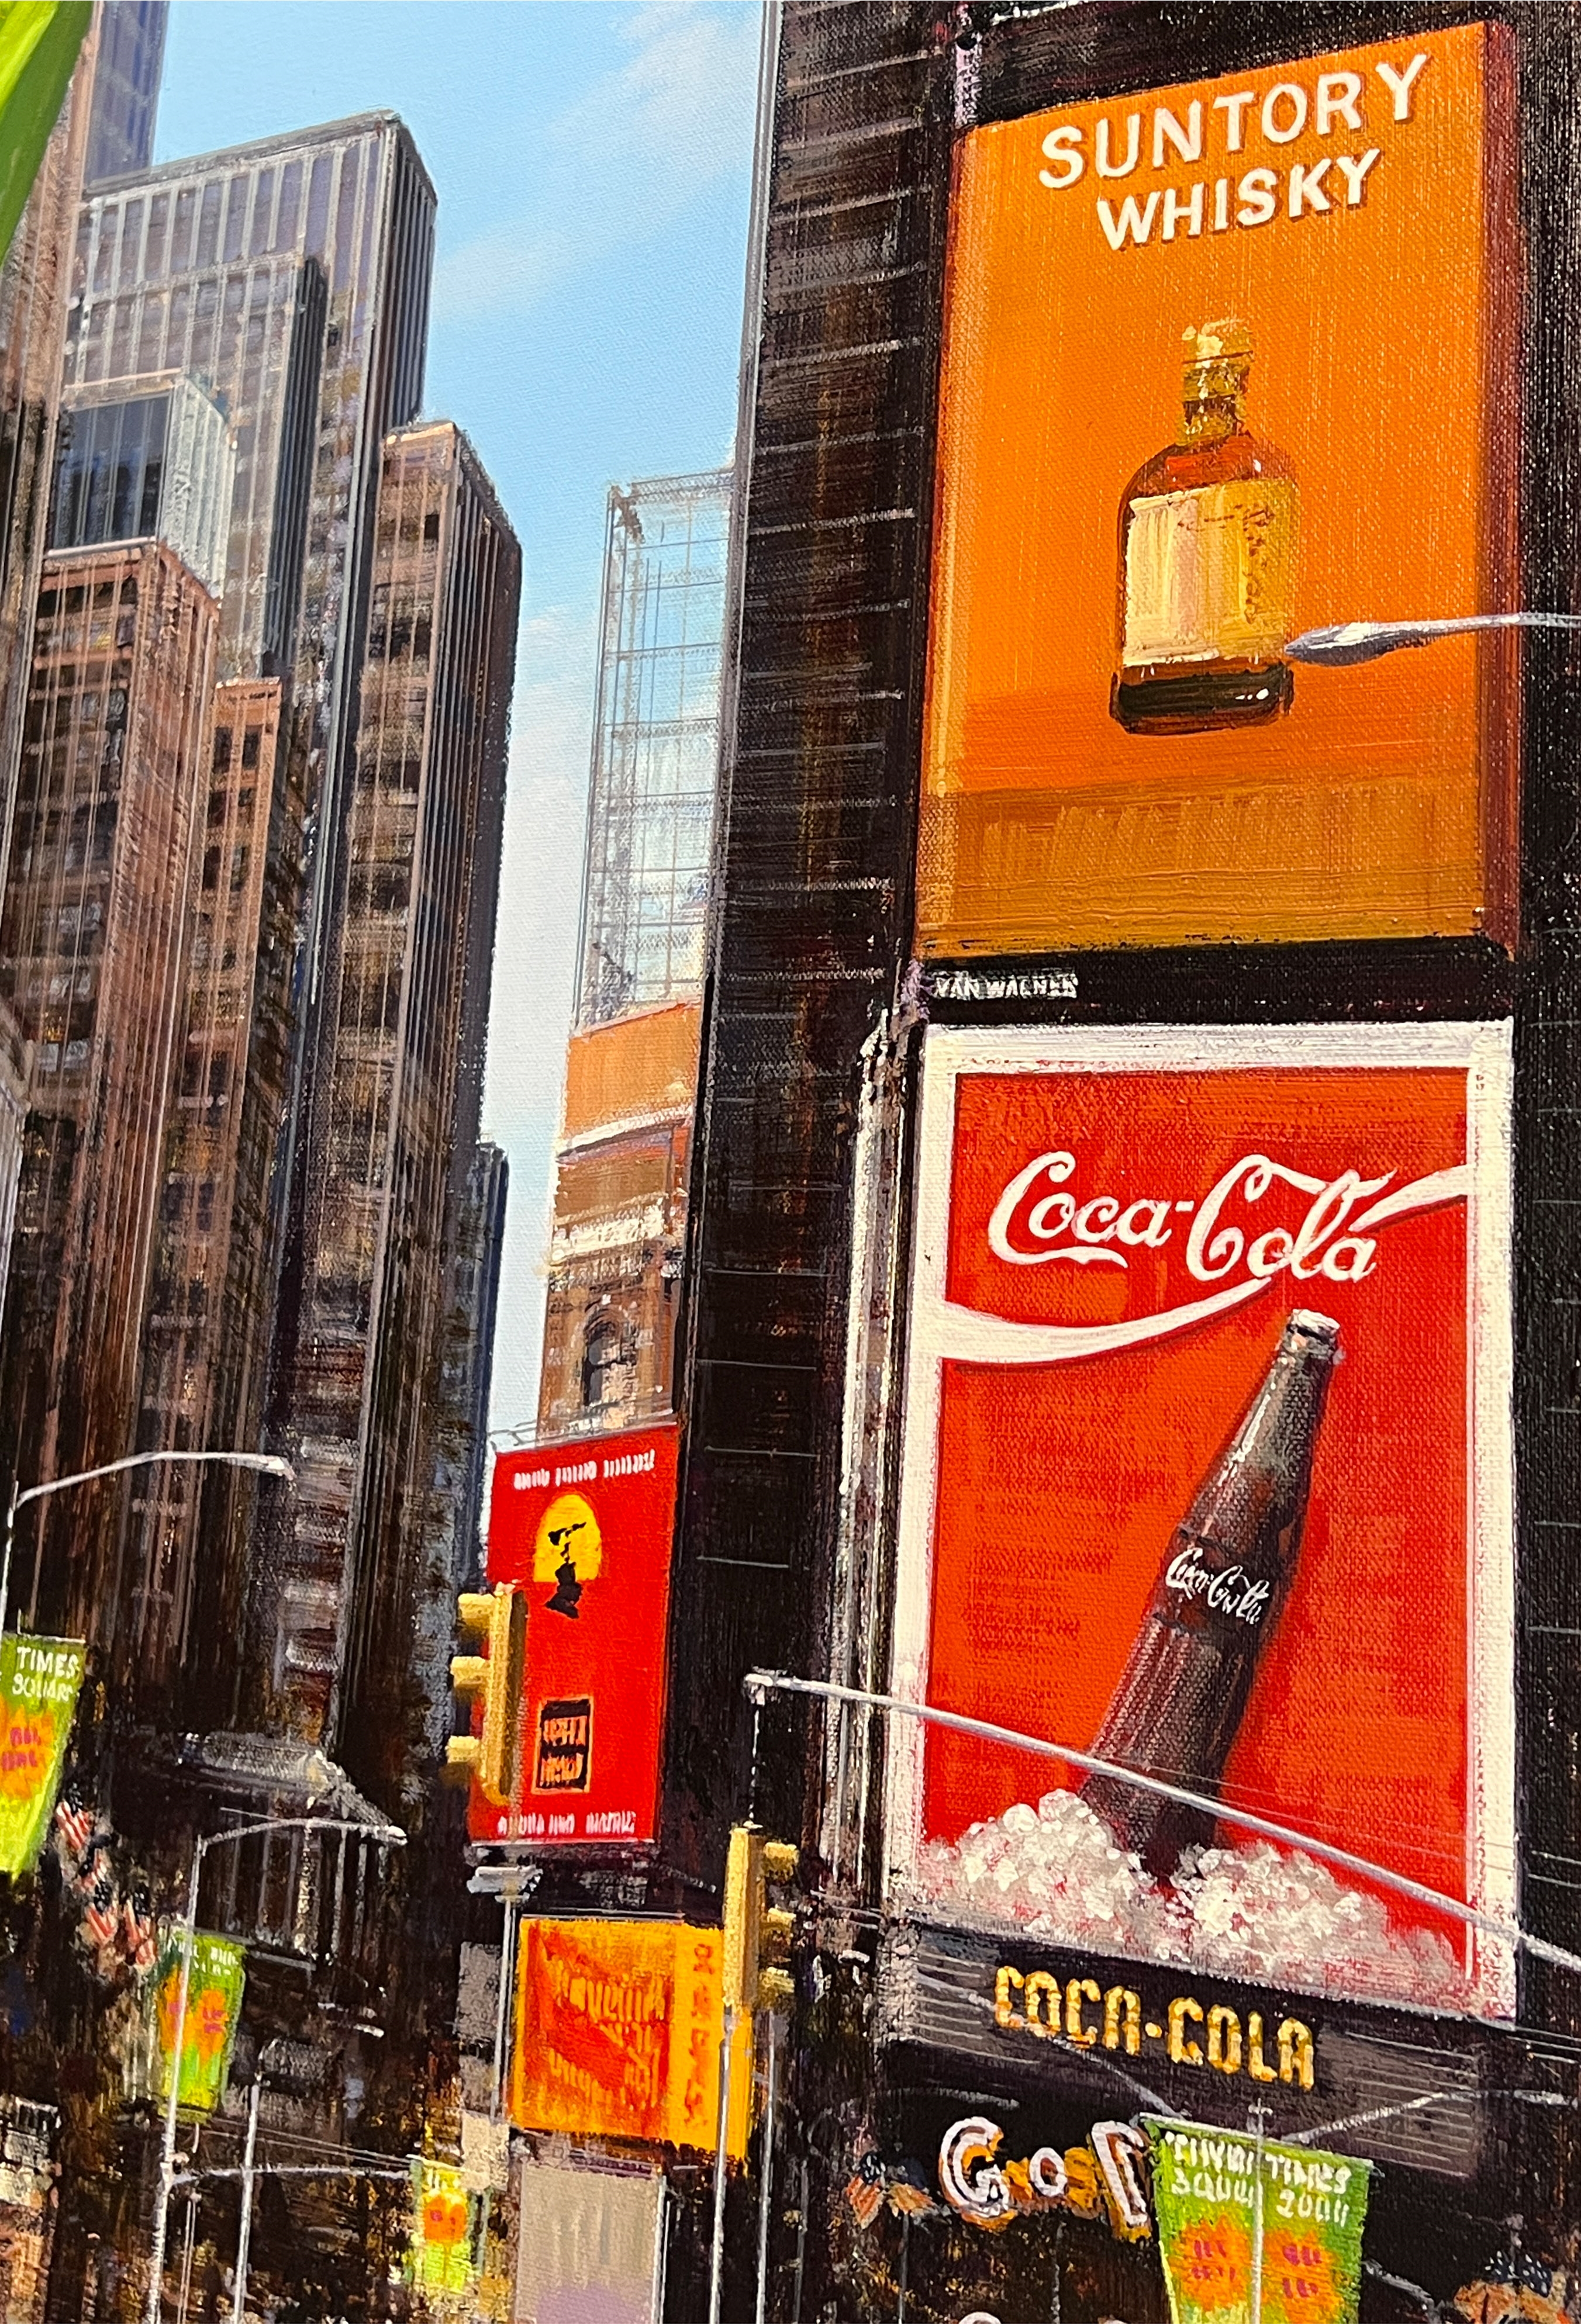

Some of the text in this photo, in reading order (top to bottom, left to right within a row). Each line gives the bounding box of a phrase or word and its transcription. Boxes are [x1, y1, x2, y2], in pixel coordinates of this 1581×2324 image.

[1038, 53, 1429, 189] SUNTORY
[1096, 148, 1380, 251] WHISKY
[988, 1150, 1396, 1282] Coca-Cola
[17, 1645, 80, 1679] TIMES
[993, 1965, 1314, 2091] COCA-COLA
